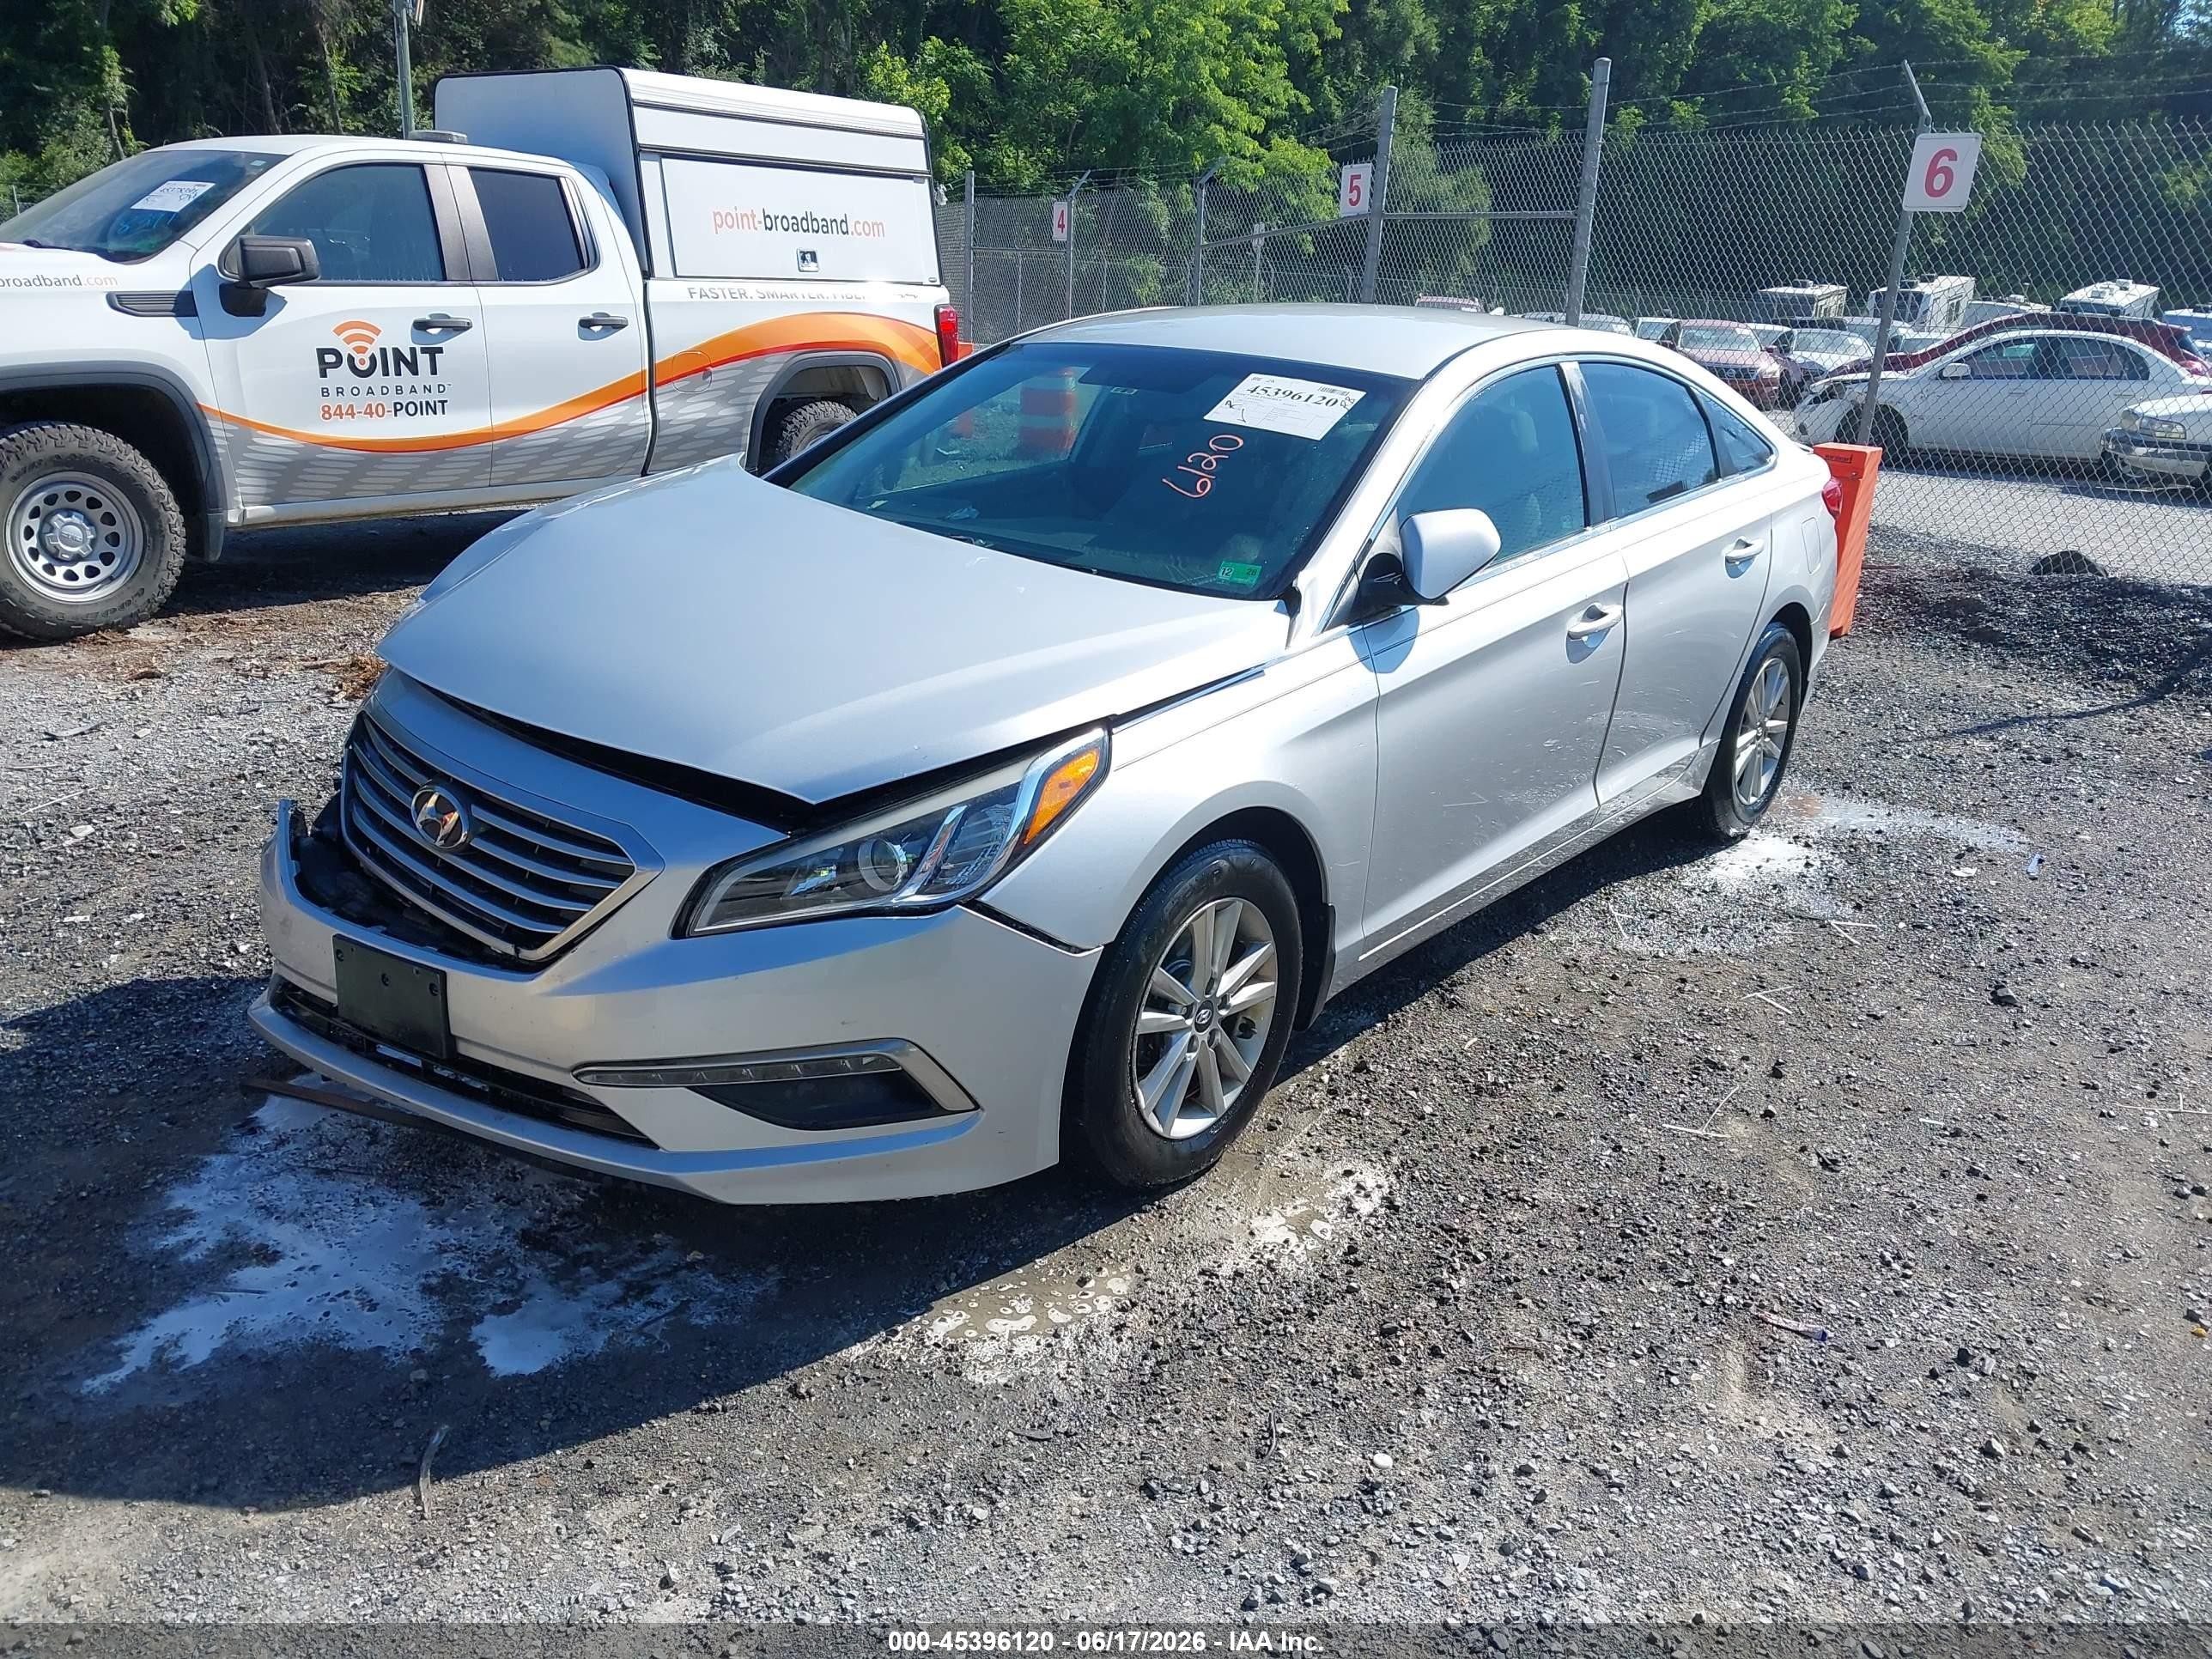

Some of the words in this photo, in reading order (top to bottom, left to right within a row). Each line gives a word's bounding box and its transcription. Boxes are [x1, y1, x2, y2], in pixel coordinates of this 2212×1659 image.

[1924, 148, 1958, 198] 6
[1348, 173, 1362, 207] 5
[712, 206, 885, 238] point-broadband.com
[1057, 209, 1066, 234] 4
[686, 286, 754, 301] FASTER.
[315, 346, 445, 379] POINT
[320, 399, 449, 421] 844-40-POINT
[1246, 385, 1338, 408] 45396120
[1162, 434, 1244, 498] 6120
[1221, 568, 1233, 577] 12
